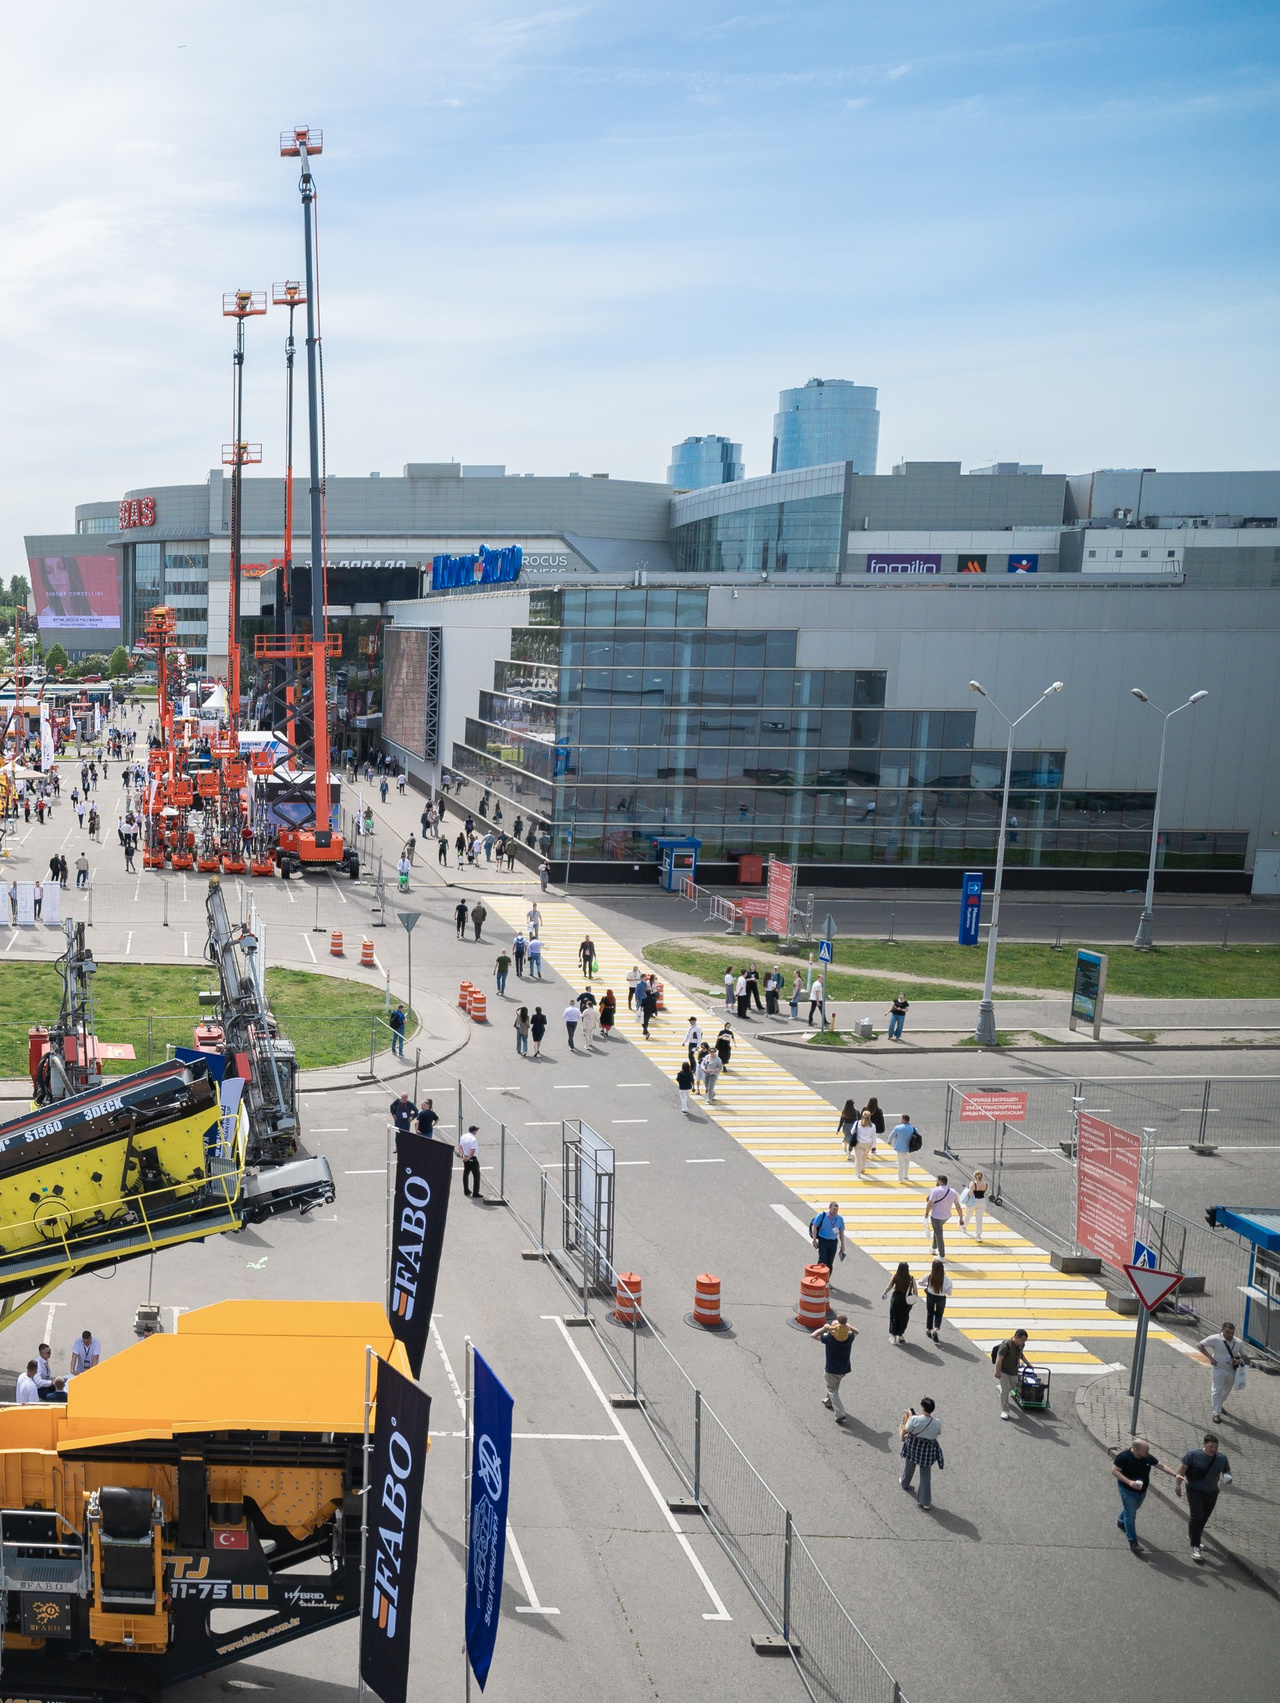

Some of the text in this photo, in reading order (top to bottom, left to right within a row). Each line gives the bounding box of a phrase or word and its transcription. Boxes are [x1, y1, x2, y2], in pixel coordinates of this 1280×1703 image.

[83, 1098, 125, 1122] 3DECK
[24, 1120, 63, 1143] S1560
[392, 1175, 432, 1303] FABO
[373, 1431, 412, 1610] FABO
[484, 1510, 500, 1627] КАРЬЕРНЫЙ КЛУБ
[20, 1581, 65, 1591] FABO
[171, 1583, 228, 1600] 11-75
[284, 1585, 325, 1606] HYBRID
[30, 1624, 61, 1633] FABO
[216, 1617, 301, 1655] www.fabo.com.tr
